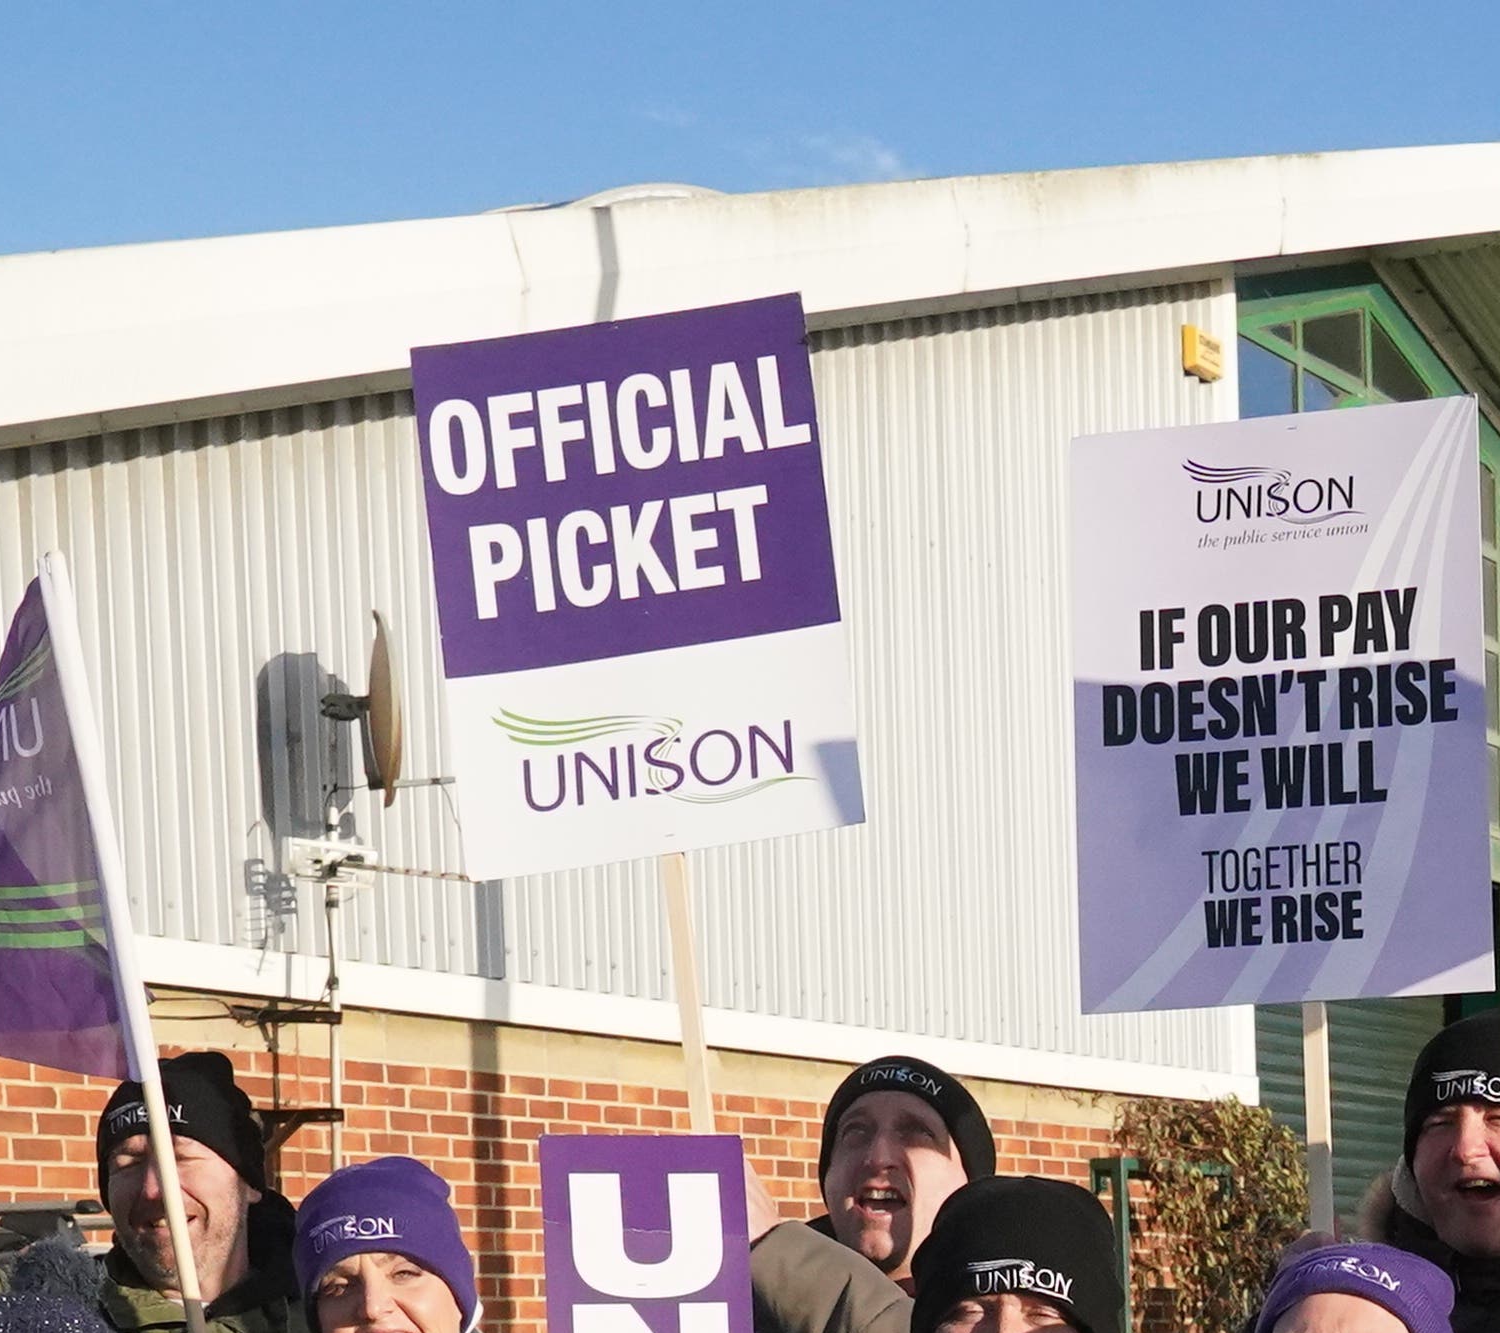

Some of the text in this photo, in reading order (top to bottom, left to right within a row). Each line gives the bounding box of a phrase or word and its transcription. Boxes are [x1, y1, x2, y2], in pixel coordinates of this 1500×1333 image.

[428, 355, 811, 496] OFFICIAL
[1196, 475, 1355, 524] UNISON
[467, 485, 770, 620] PICKET
[1197, 522, 1368, 550] the public service union
[1139, 587, 1418, 670] IF OUR PAY
[1103, 659, 1458, 747] DOESN'T RISE
[522, 720, 794, 812] UNISON
[1175, 741, 1387, 817] WE WILL
[1202, 841, 1363, 894] TOGETHER
[1205, 890, 1363, 948] WE RISE
[860, 1065, 944, 1097] UNISON
[111, 1102, 184, 1134] UNISN
[313, 1216, 395, 1255] UNISON
[974, 1262, 1073, 1299] UNISON
[1296, 1256, 1401, 1292] UNISON
